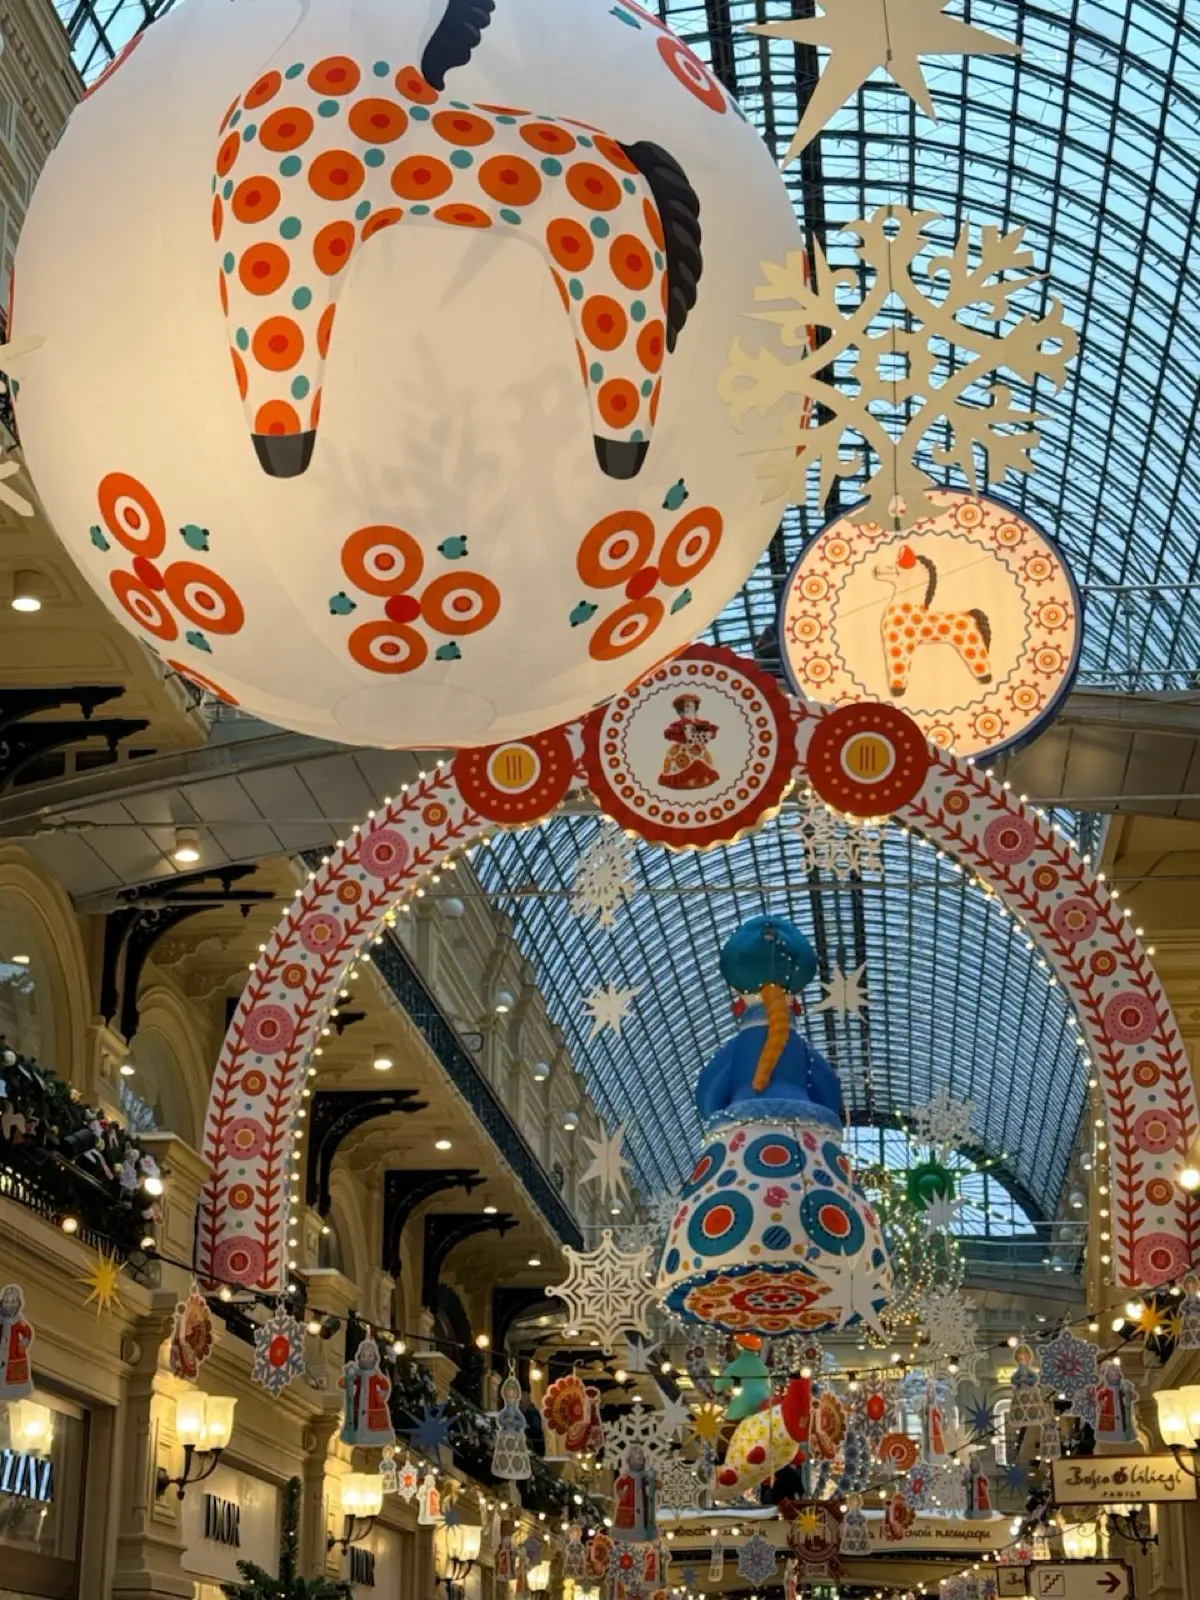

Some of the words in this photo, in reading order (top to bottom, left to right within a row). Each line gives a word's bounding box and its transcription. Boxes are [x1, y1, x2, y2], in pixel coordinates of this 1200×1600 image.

[1065, 1465, 1111, 1490] Bosco
[1130, 1464, 1182, 1491] Ciliegi
[203, 1493, 241, 1548] DIOR
[936, 1529, 991, 1543] площади
